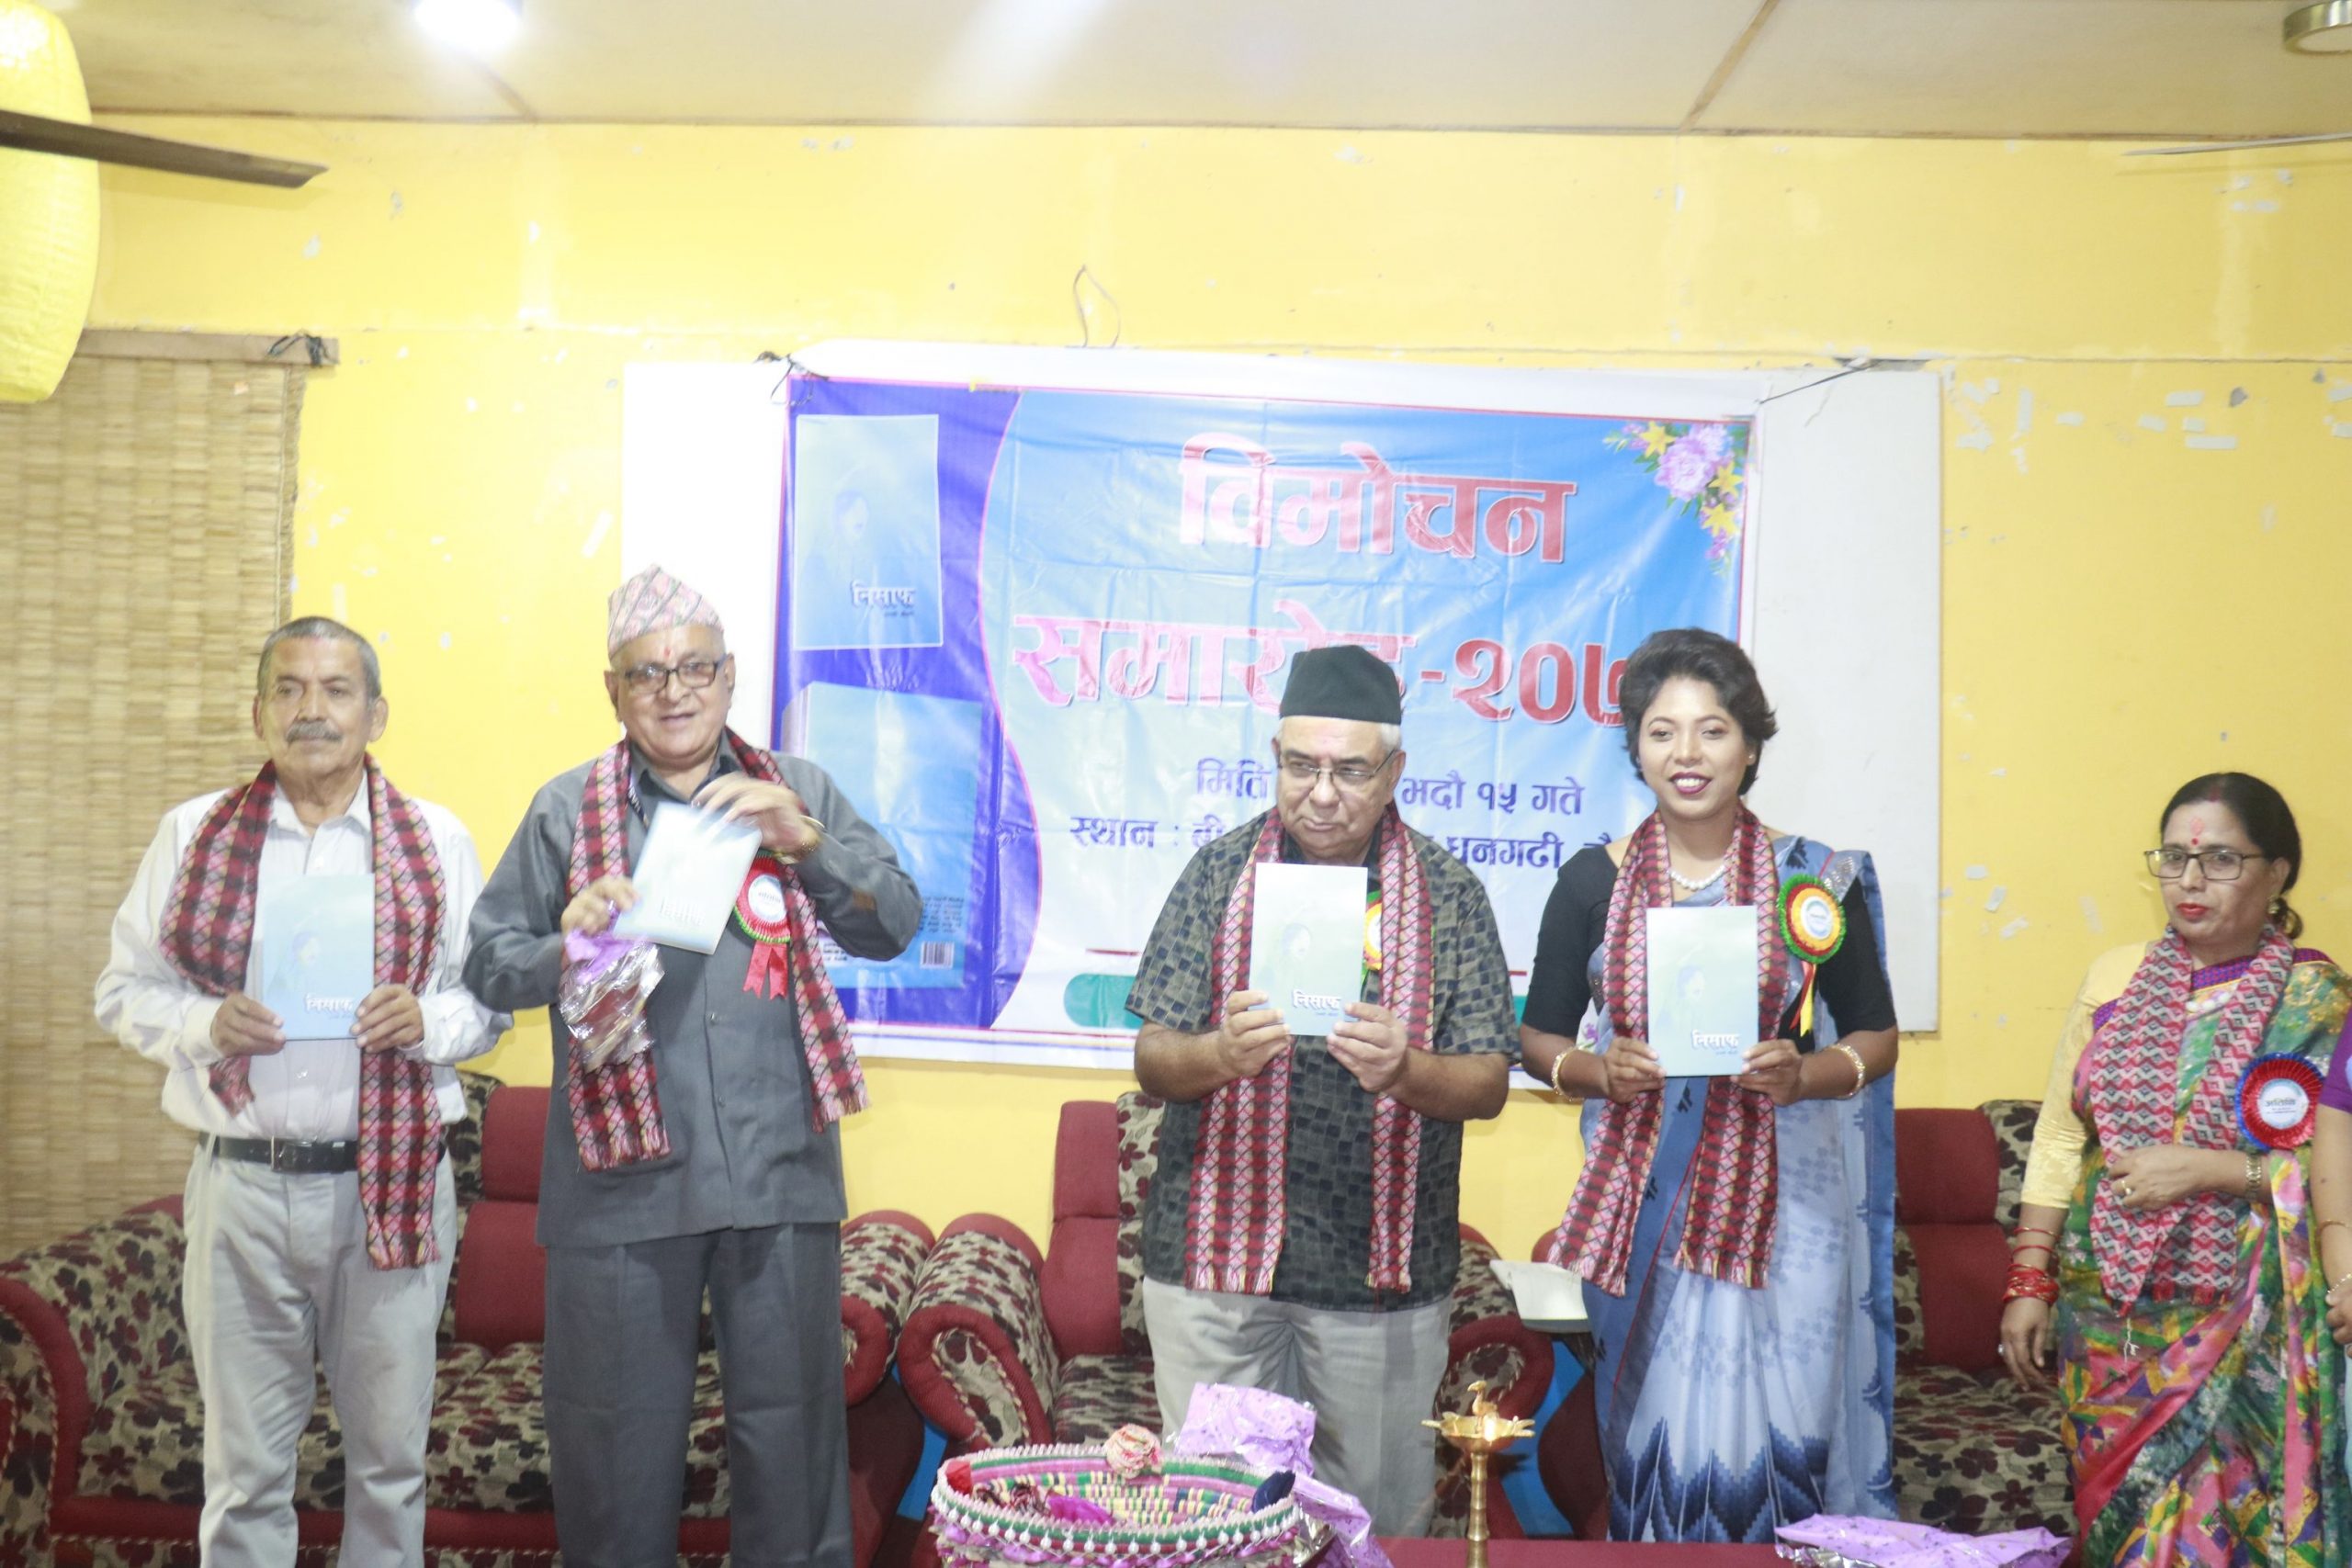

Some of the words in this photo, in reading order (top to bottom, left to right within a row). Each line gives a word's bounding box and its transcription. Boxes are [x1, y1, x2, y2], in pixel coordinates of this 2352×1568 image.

[1180, 432, 1577, 563] विमोचन
[1401, 770, 1466, 810] भदौ
[1476, 782, 1517, 814] १५
[1531, 775, 1586, 816] गते
[1070, 817, 1159, 848] स्थान
[1291, 987, 1342, 1011] निसाफ
[1690, 1028, 1742, 1050] निसाफ
